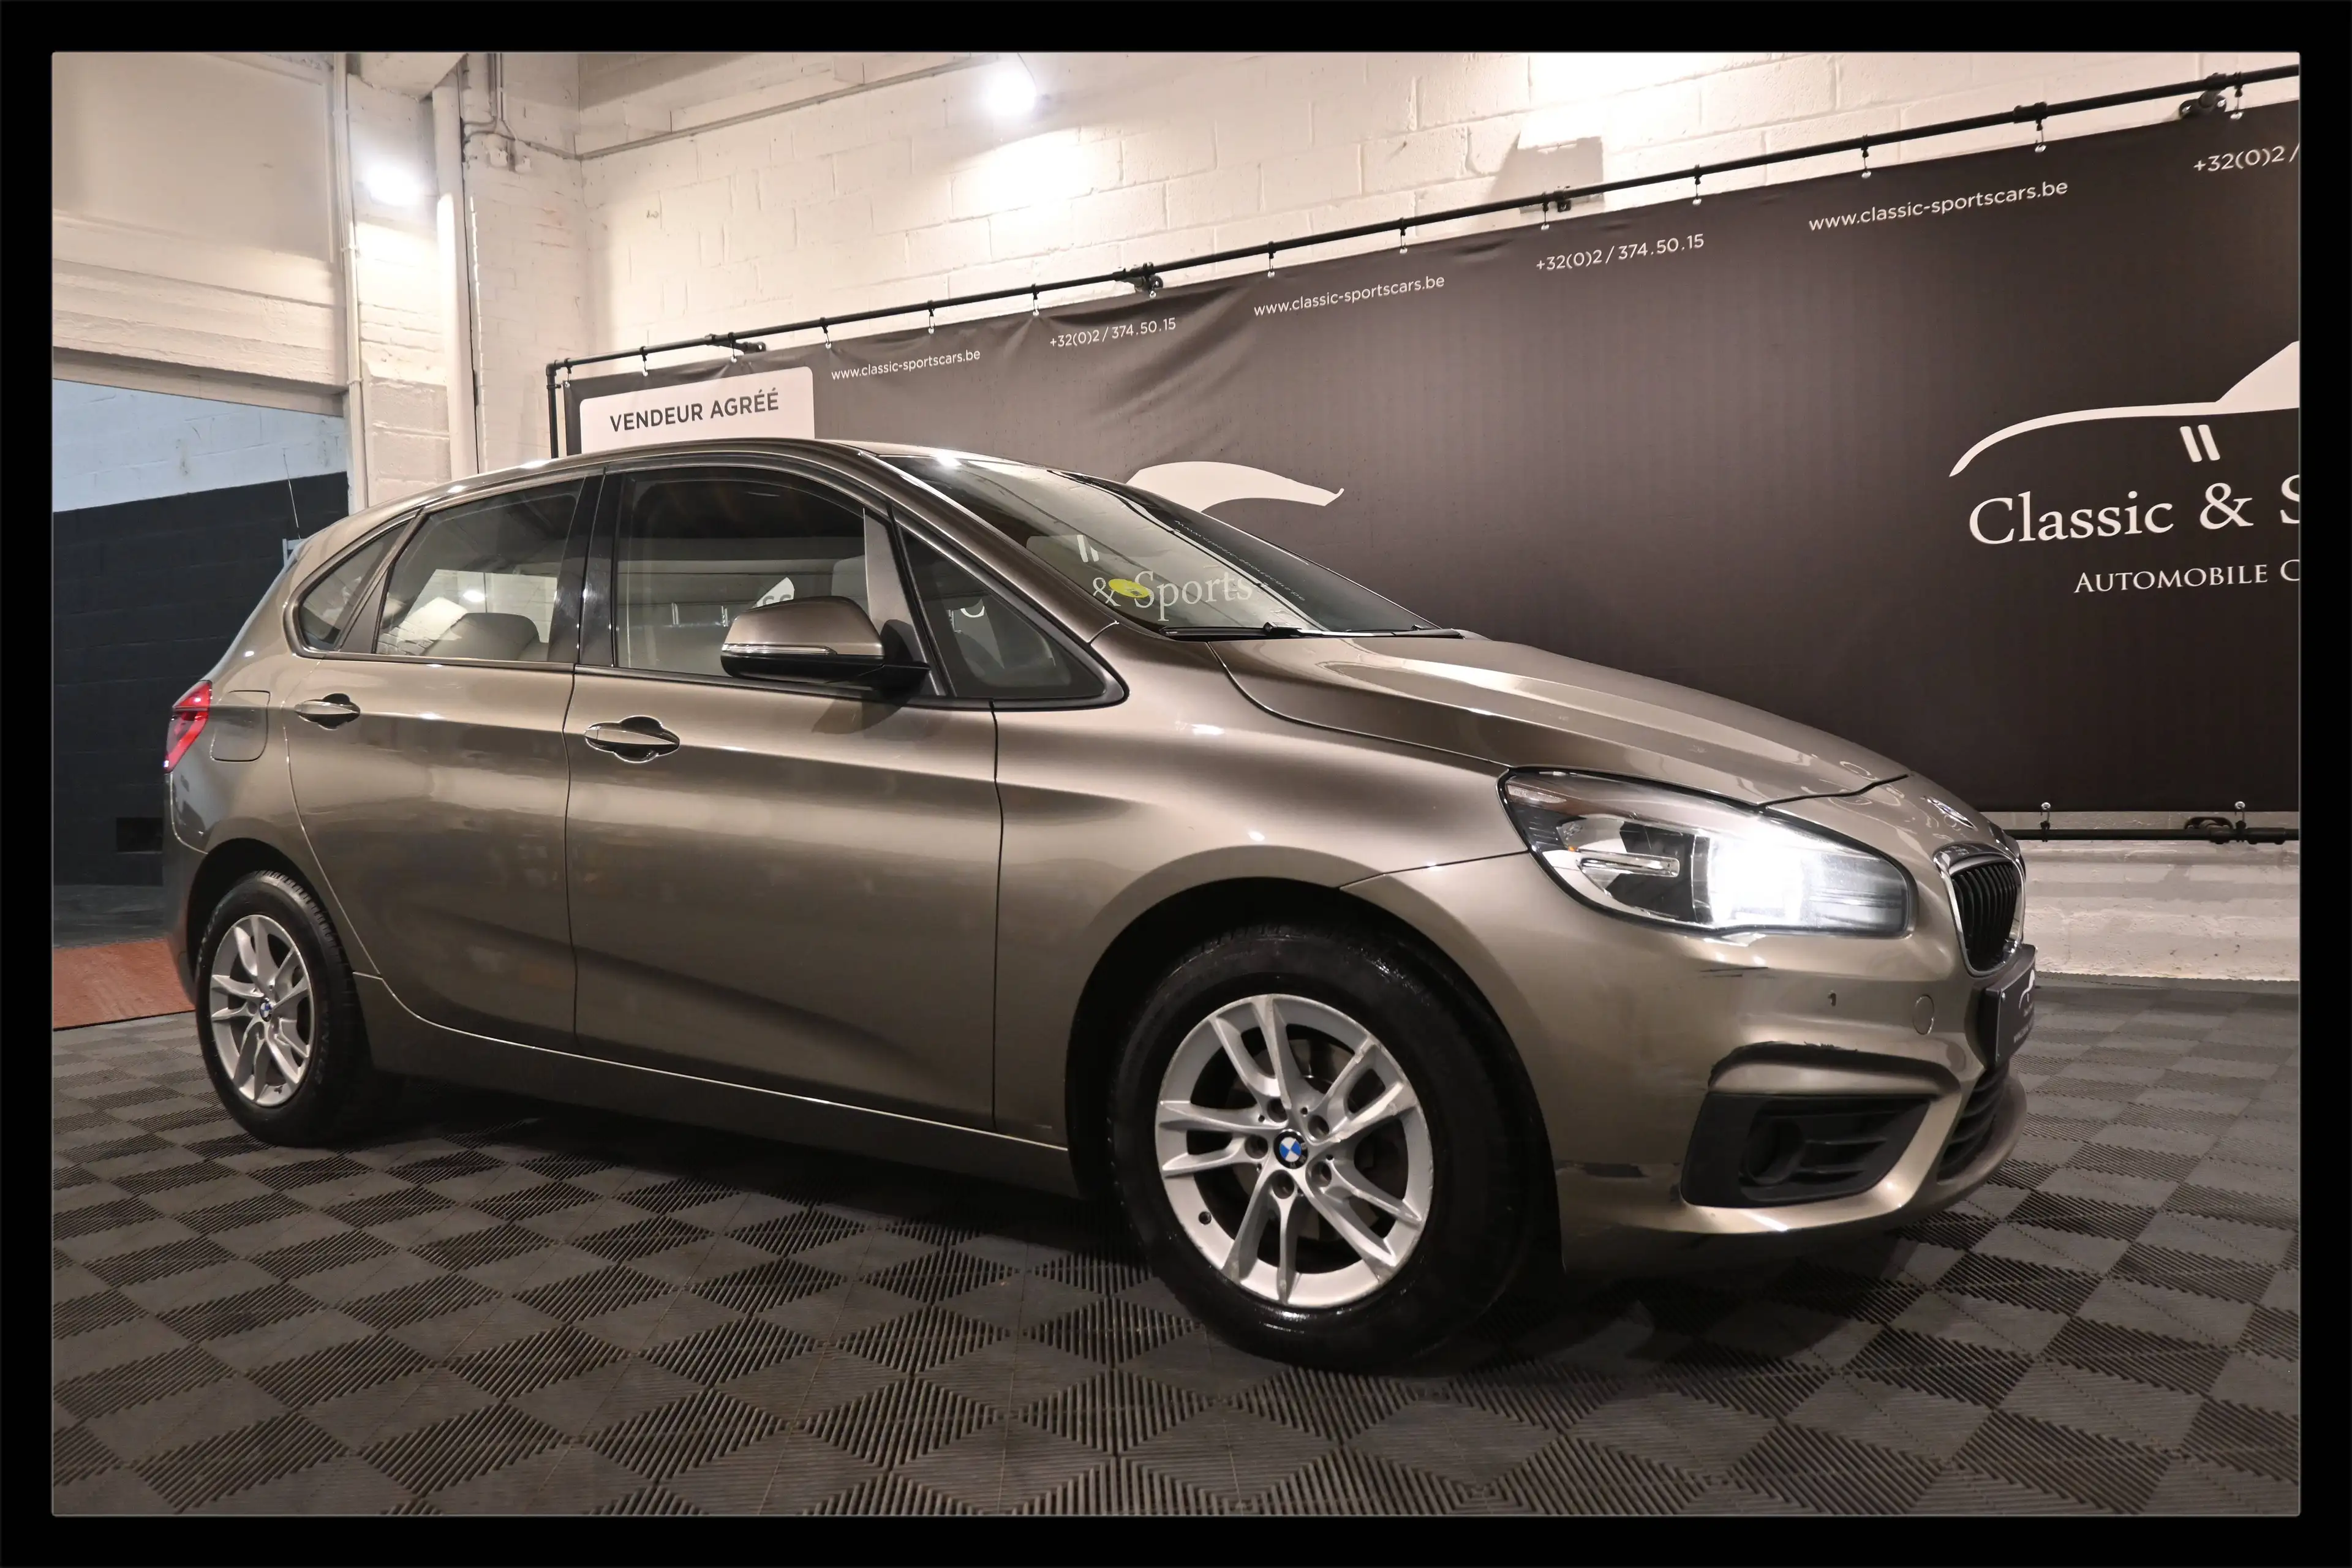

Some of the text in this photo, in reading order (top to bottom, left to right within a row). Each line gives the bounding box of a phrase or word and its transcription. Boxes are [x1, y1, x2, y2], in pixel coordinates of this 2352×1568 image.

[1808, 181, 2068, 232] www.classic-sportscars.be
[1254, 276, 1446, 317] www.classic-sportscars.be
[831, 349, 981, 381] www.classic-sportscars.be
[609, 387, 779, 433] VENDEUR AGRÉÉ
[1969, 491, 2174, 545] Classic
[2199, 482, 2254, 530] &
[1134, 571, 1253, 621] Sports
[2073, 564, 2267, 594] AUTOMOBILE
